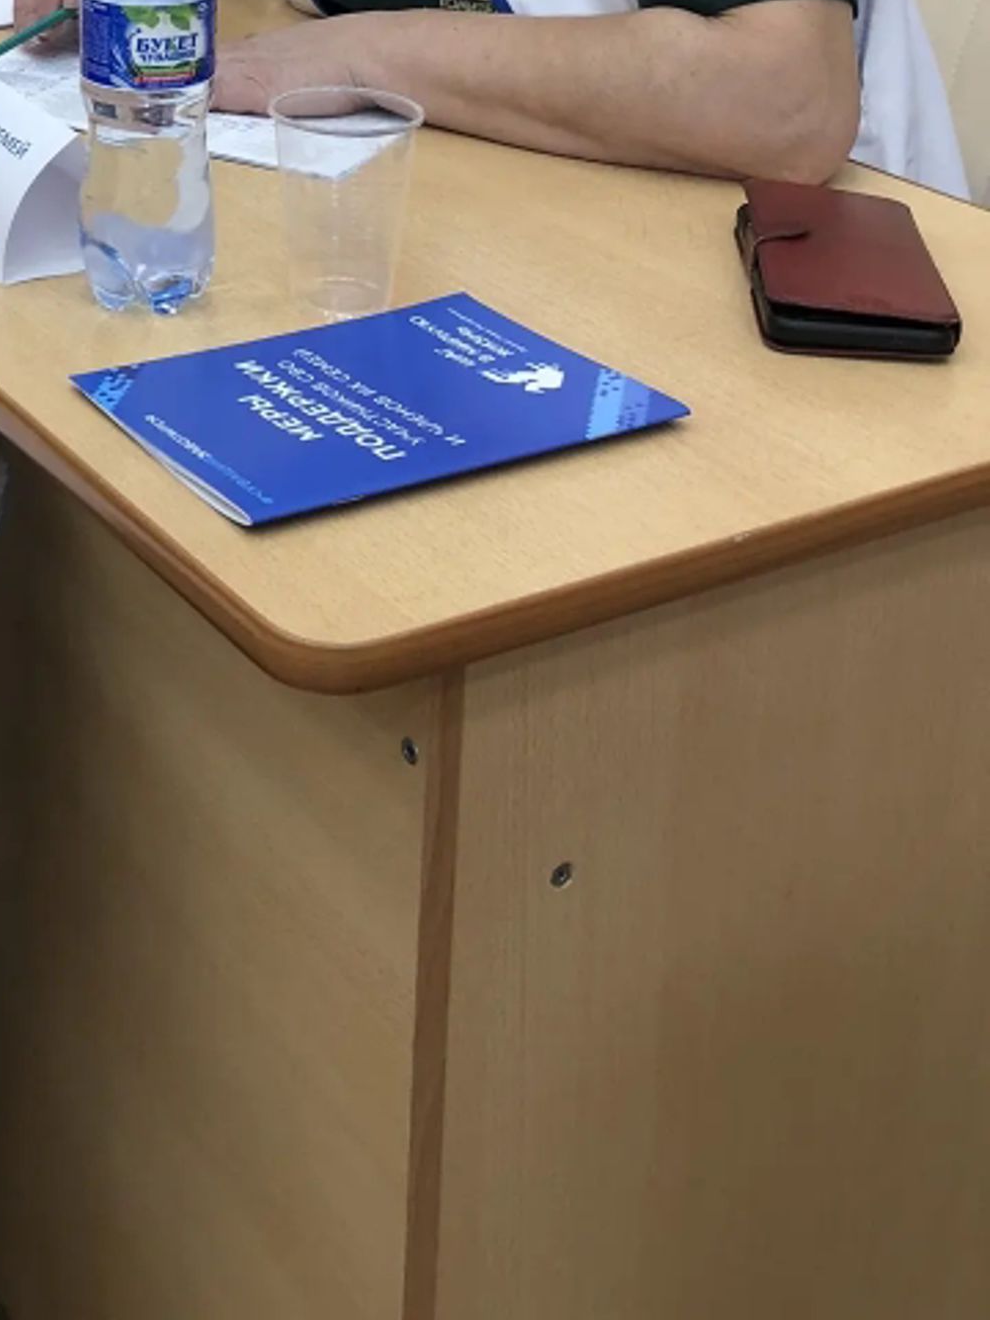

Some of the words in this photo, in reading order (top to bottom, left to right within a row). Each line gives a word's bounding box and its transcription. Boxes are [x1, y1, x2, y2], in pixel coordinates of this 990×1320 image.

[136, 33, 198, 53] БУКЕТ
[277, 359, 314, 384] СВО
[292, 347, 351, 382] СЕМЕЙ
[346, 381, 377, 398] ИХ
[234, 360, 407, 460] ПОДДЕРЖКИ
[237, 394, 324, 442] МЕРЫ
[311, 382, 426, 446] УЧАСТНИКОВ
[373, 394, 444, 436] ЧЛЕНОВ
[444, 434, 467, 446] И
